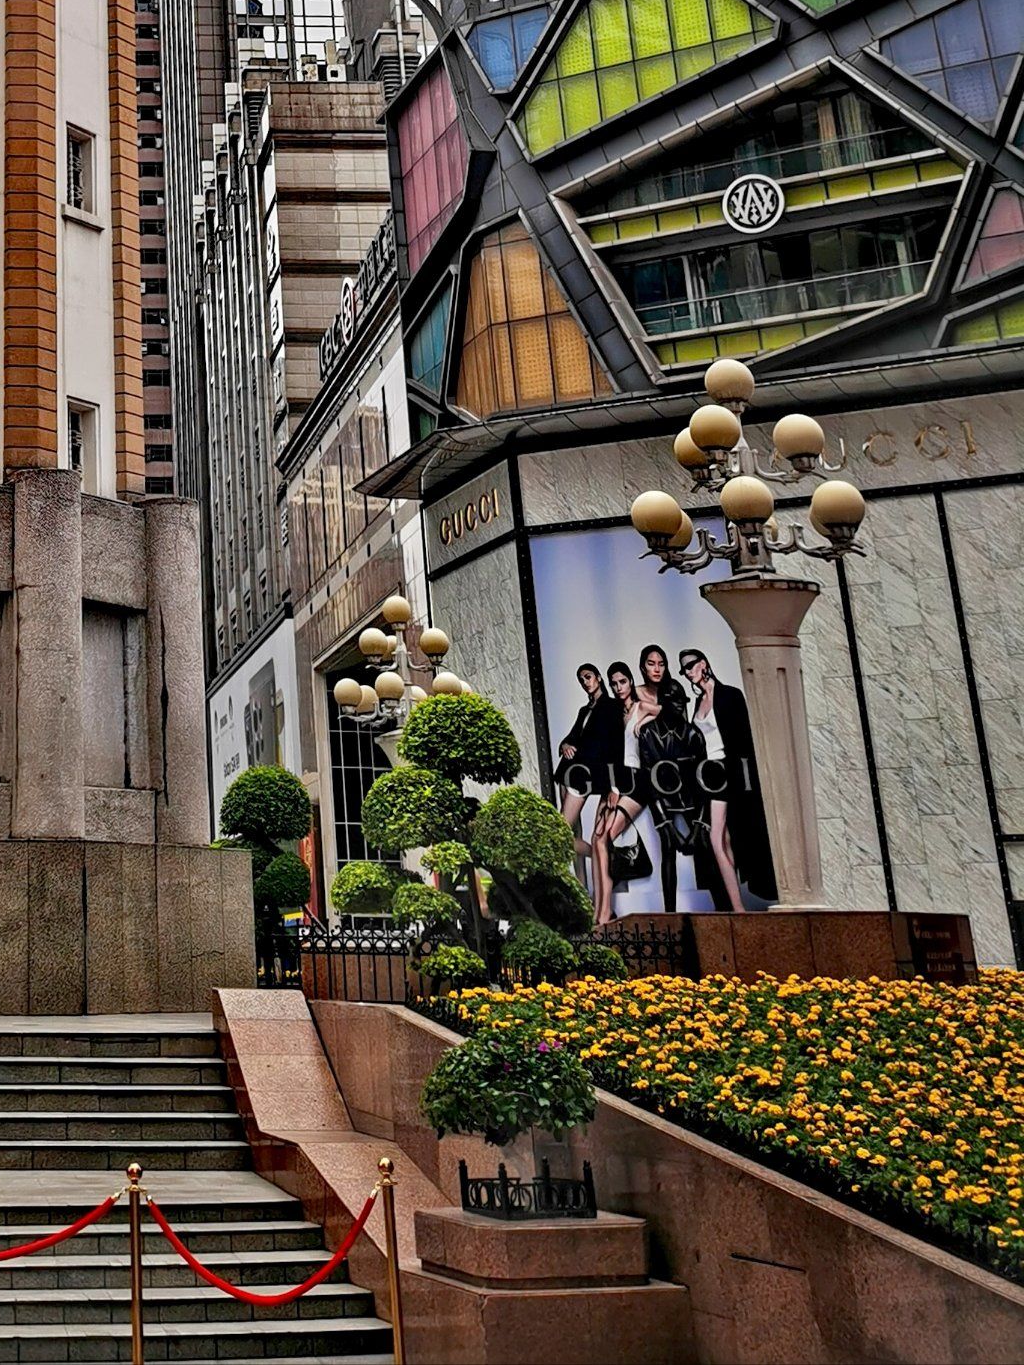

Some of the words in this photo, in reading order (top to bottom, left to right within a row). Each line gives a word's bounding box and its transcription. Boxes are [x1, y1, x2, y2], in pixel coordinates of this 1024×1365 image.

[770, 419, 977, 473] UCCI
[439, 487, 499, 546] GUCCI
[563, 756, 753, 799] GUCCI
